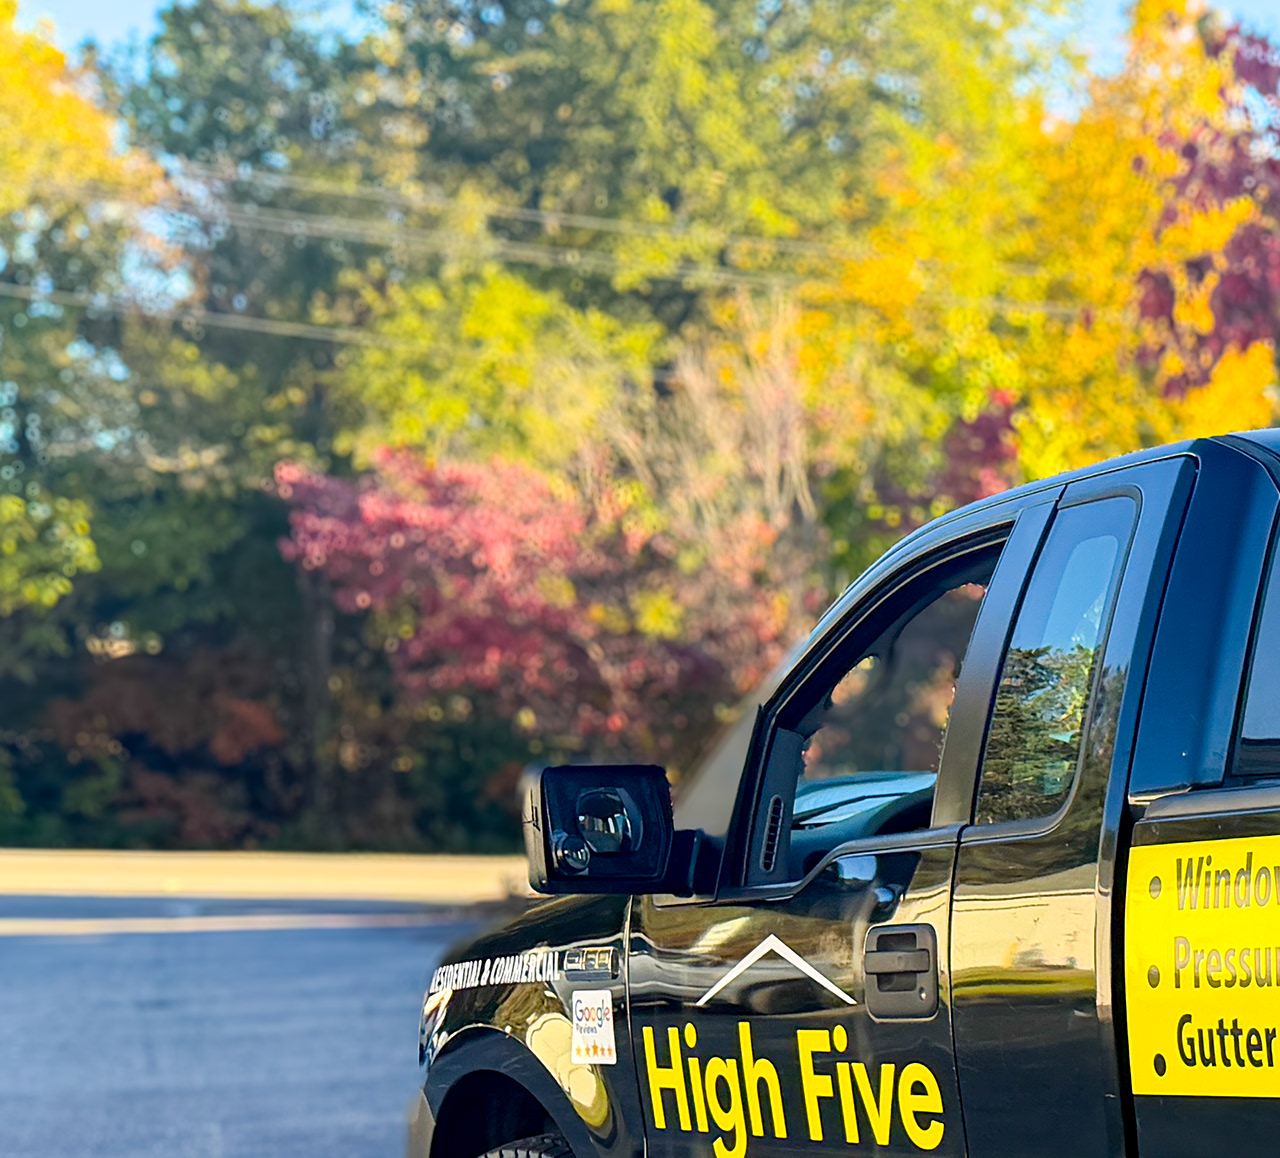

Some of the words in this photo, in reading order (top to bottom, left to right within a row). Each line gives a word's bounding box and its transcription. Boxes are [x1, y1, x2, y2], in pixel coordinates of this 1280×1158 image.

[429, 959, 482, 993] RESIDENTIAL
[481, 958, 491, 987] &
[490, 951, 561, 985] COMMERCIAL
[574, 999, 611, 1028] Google
[1176, 1013, 1276, 1068] Gutter
[797, 1024, 946, 1151] Five
